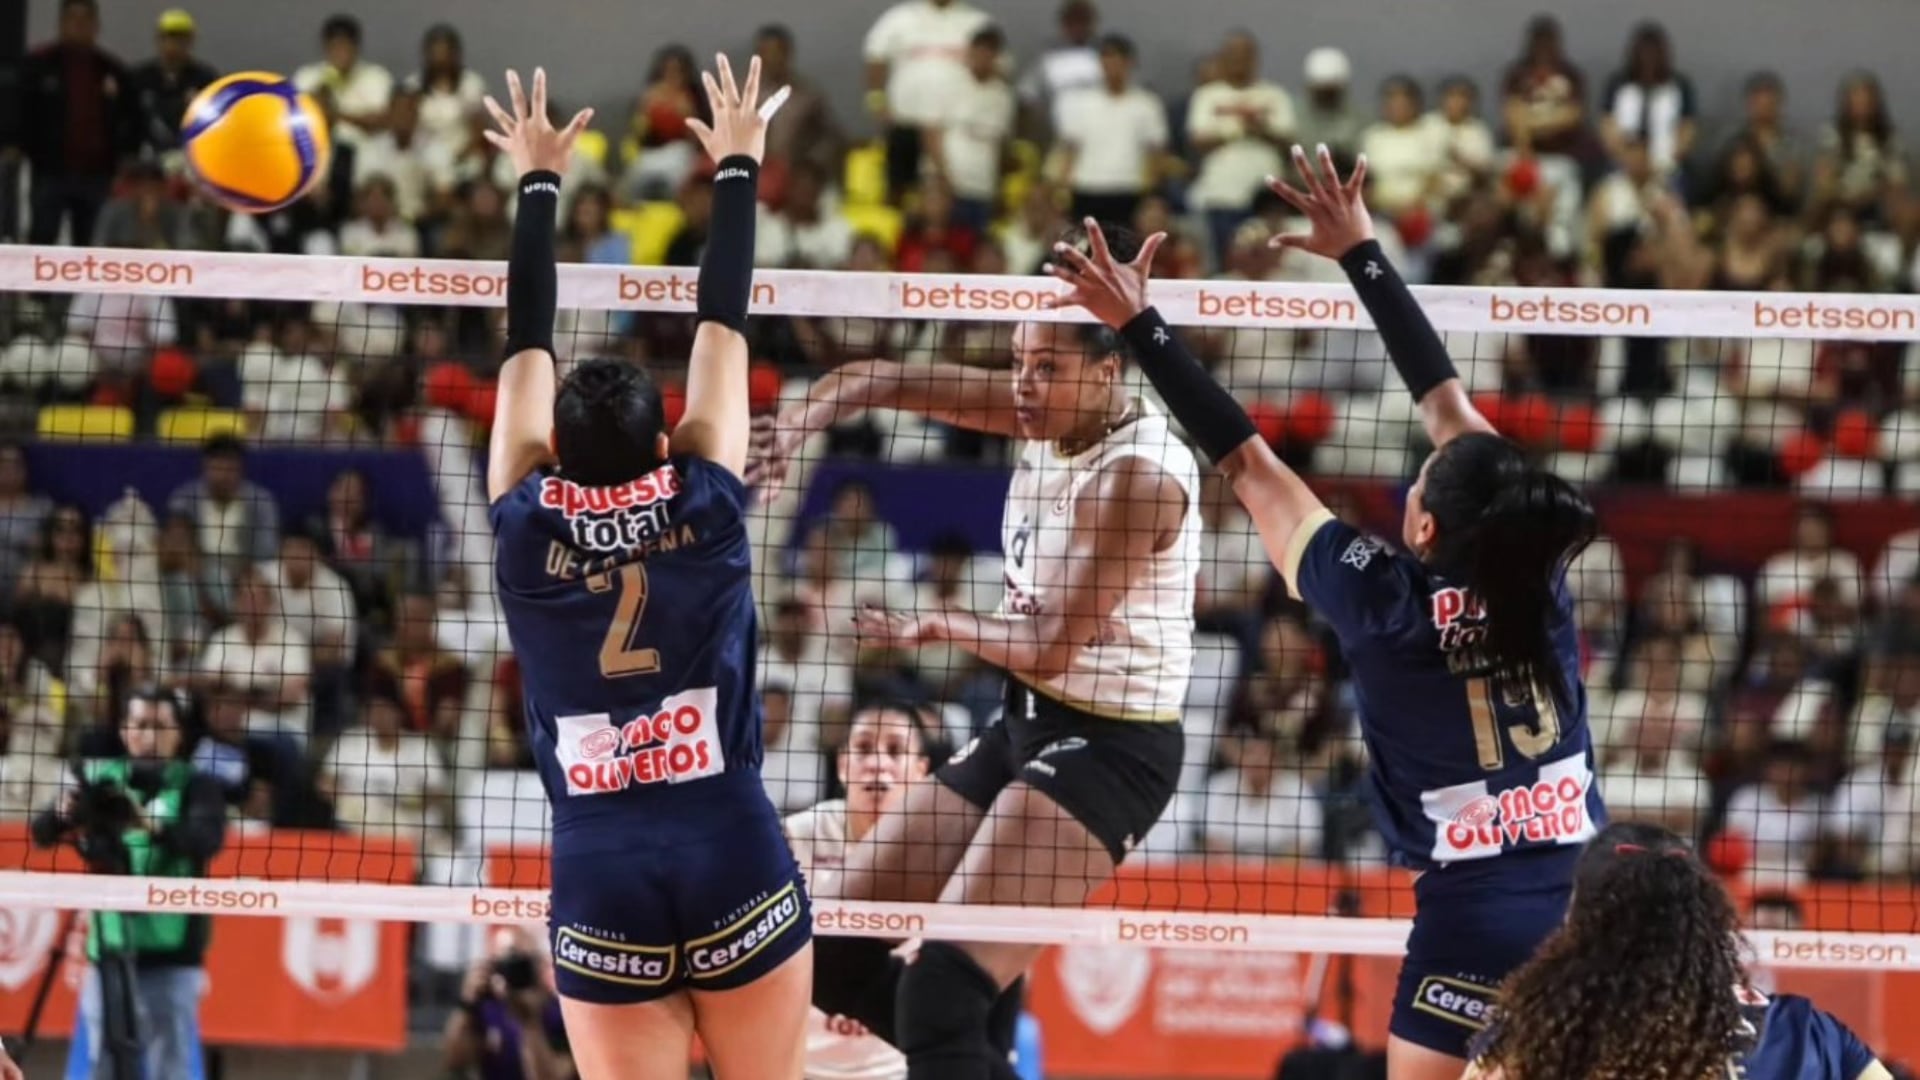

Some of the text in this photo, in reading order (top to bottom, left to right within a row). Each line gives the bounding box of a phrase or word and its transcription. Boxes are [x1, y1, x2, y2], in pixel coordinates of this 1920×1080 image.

[714, 167, 749, 181] walo
[34, 257, 193, 284] betsson
[619, 274, 775, 304] betsn
[1199, 290, 1355, 320] betsson
[1491, 294, 1649, 325] betsson
[1755, 301, 1914, 329] betsson
[540, 465, 682, 519] apuesta
[570, 502, 670, 551] total
[545, 539, 577, 579] DE
[585, 561, 661, 679] 2
[568, 739, 710, 790] OLIVEROS
[1499, 776, 1582, 825] SACO
[1446, 804, 1584, 850] OLIVERO
[147, 884, 279, 909] betsson
[471, 894, 552, 918] bets
[692, 896, 794, 971] Ceresita
[816, 906, 925, 931] etsson
[1118, 918, 1248, 943] betsson
[560, 936, 662, 977] Ceresita
[1773, 937, 1906, 962] betsson
[1425, 982, 1500, 1022] Ceres
